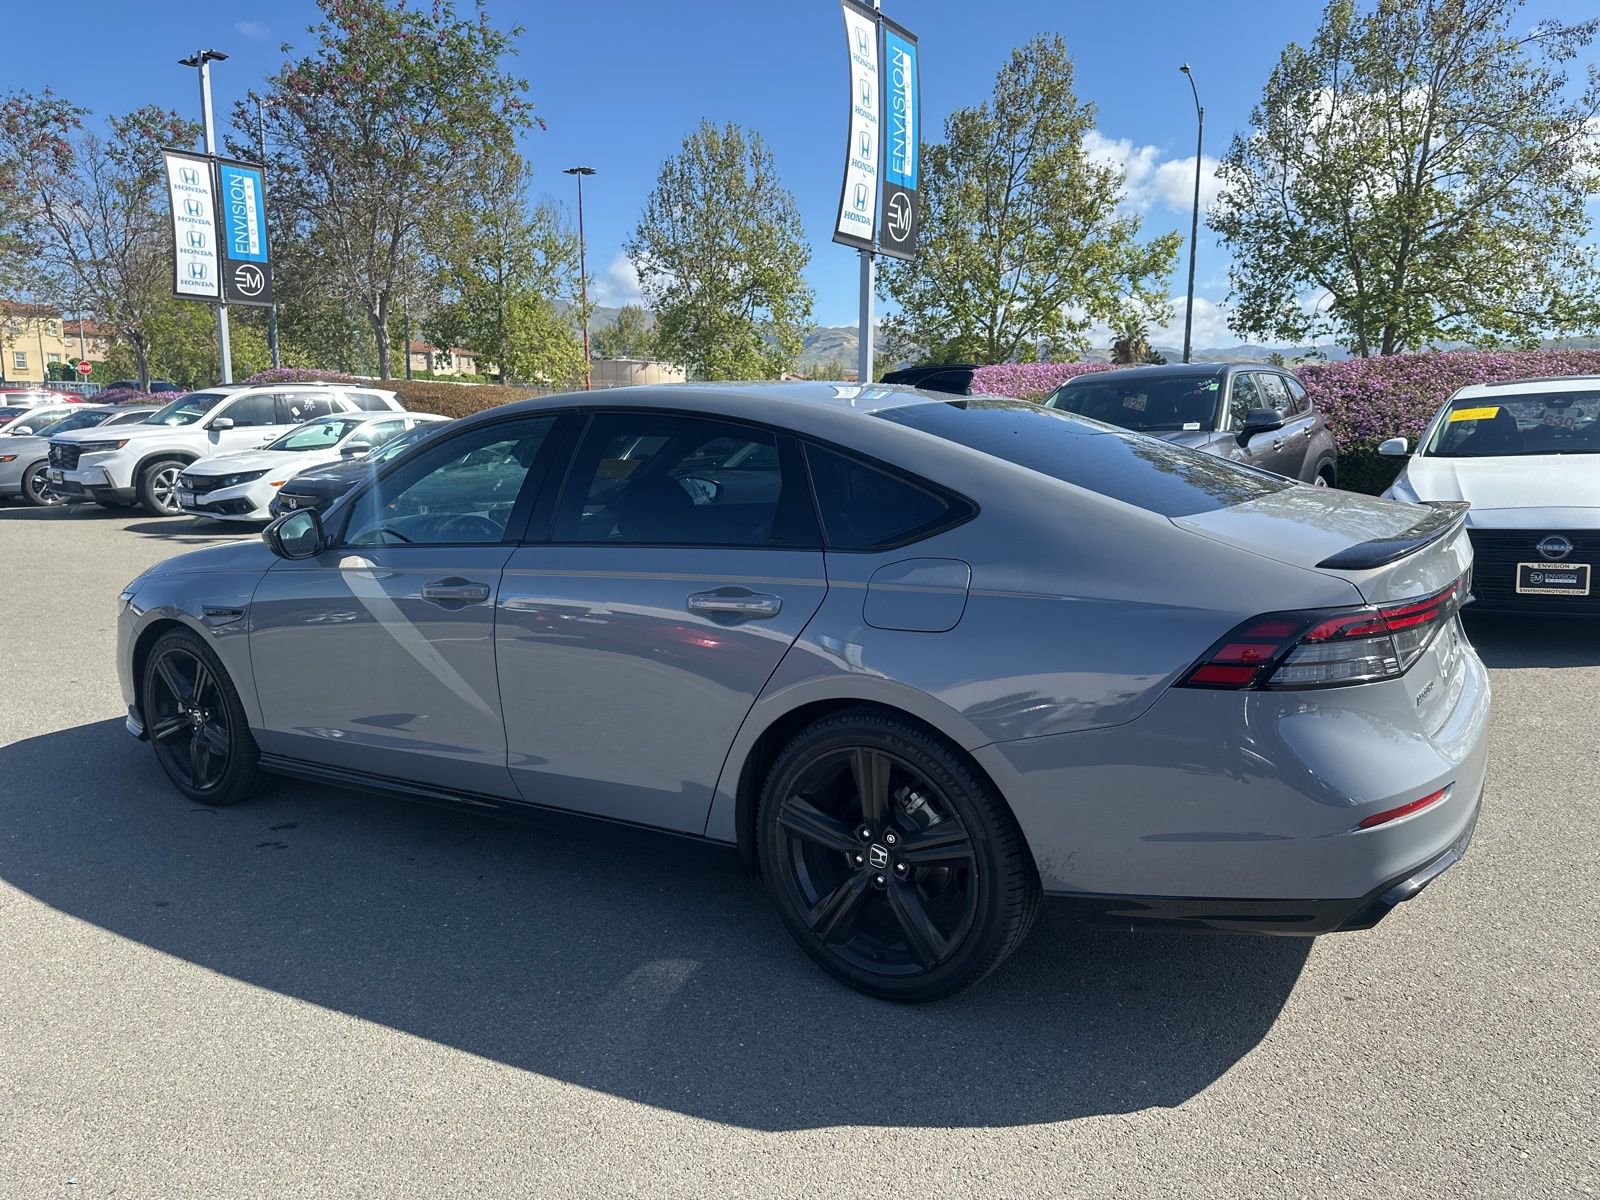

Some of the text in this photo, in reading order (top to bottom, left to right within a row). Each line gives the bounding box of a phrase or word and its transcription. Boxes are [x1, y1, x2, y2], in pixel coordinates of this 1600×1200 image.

[852, 52, 876, 73] HONDA
[855, 105, 877, 124] HONDA
[892, 46, 905, 174] ENVISION
[851, 158, 876, 175] HONDA
[174, 183, 209, 195] HONDA
[177, 216, 212, 226] HONDA
[229, 174, 249, 254] ENVISION
[247, 184, 257, 248] MOTORS
[843, 211, 871, 226] HONDA
[180, 247, 214, 257] HONDA
[180, 279, 215, 288] HONDA
